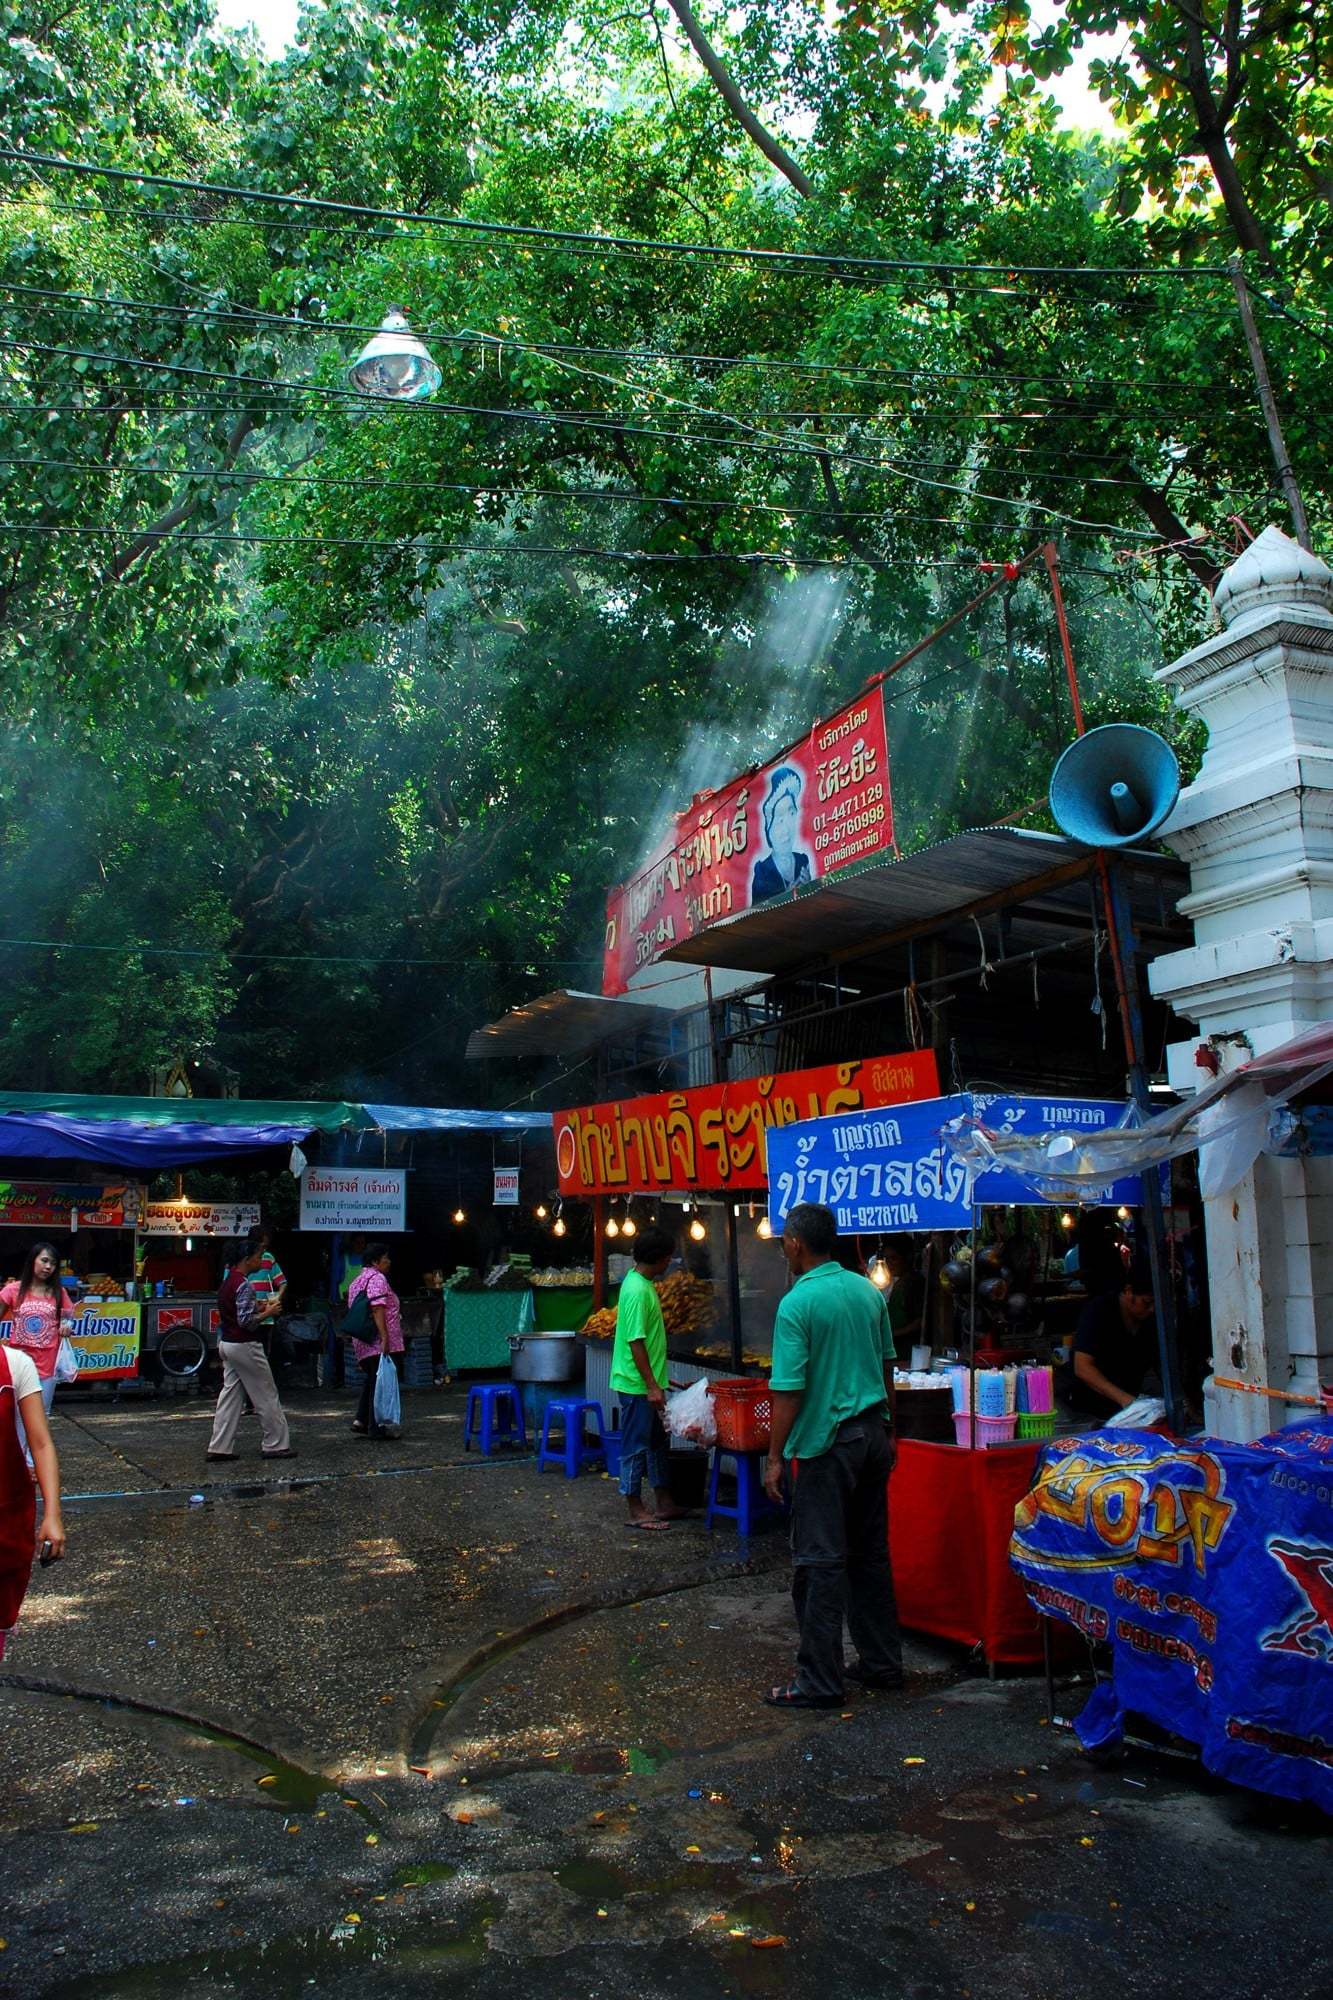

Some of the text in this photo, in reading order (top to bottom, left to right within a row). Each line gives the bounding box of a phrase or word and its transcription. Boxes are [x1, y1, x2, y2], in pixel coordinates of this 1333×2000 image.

[817, 706, 869, 751] บริการโดย
[813, 783, 884, 831] 01-4471129
[823, 829, 880, 872] ถูกหลักอนามัย
[871, 1061, 914, 1093] อิสลาม
[837, 1202, 919, 1228] 01-9278704
[73, 1344, 137, 1369] กรอกไก่
